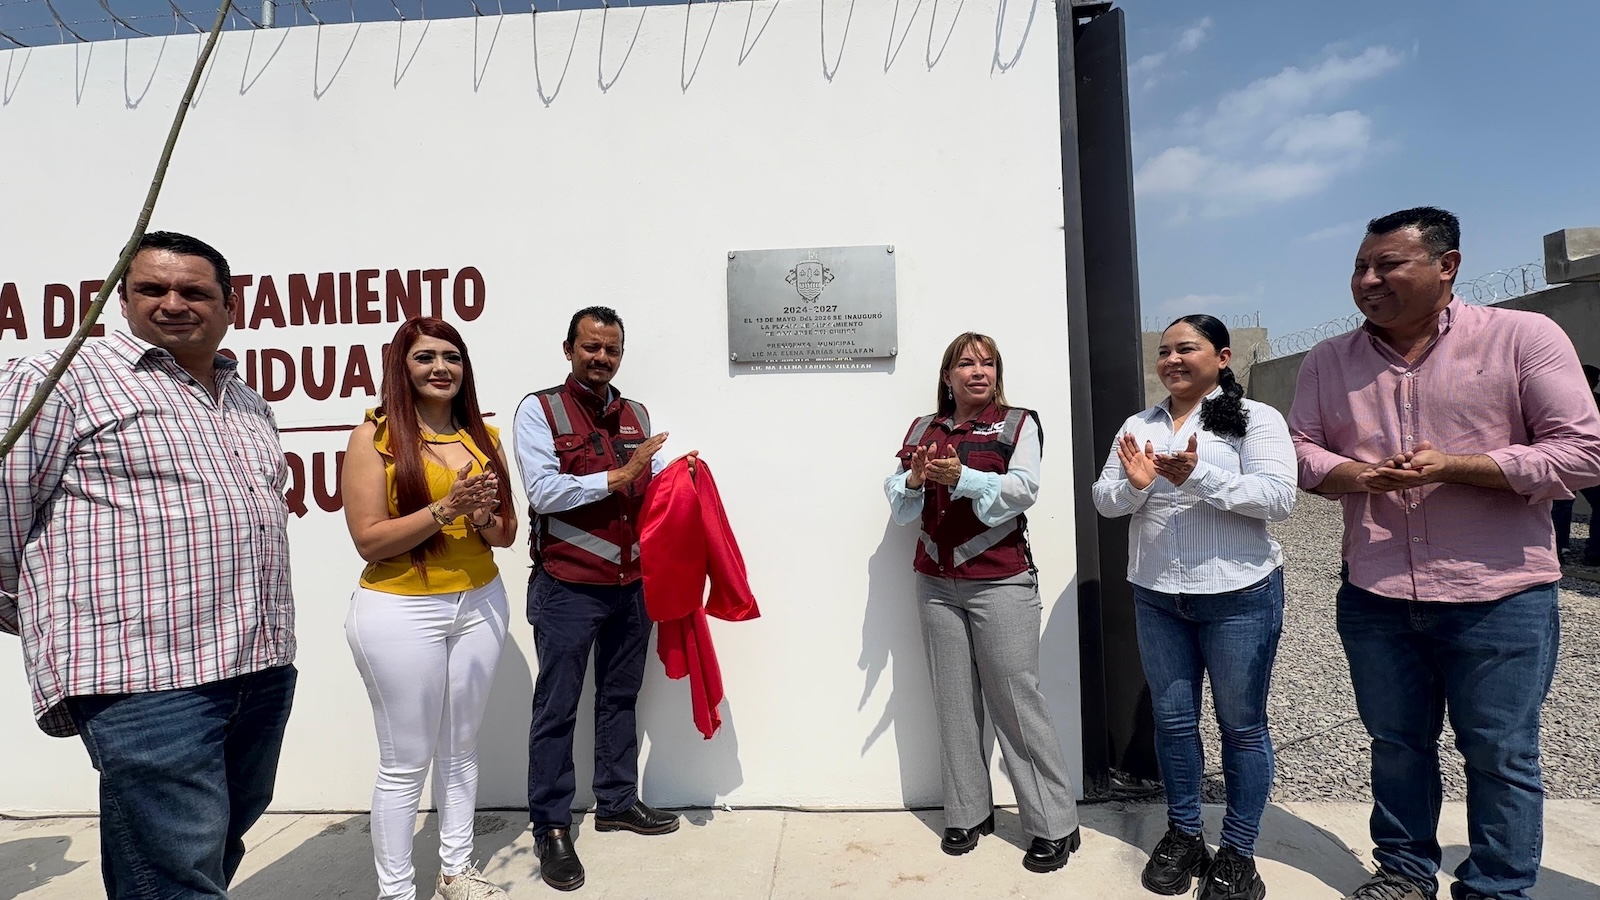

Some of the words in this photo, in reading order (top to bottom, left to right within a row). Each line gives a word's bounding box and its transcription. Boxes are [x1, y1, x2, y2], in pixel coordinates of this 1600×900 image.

[43, 279, 105, 340] DE
[230, 265, 486, 331] TAMIENTO
[783, 305, 838, 314] 2024-2027
[844, 312, 883, 320] INAUGURÓ
[817, 340, 855, 348] MUNICIPAL
[807, 348, 833, 356] FARÍAS
[218, 343, 392, 402] IDUA
[284, 450, 347, 519] QU
